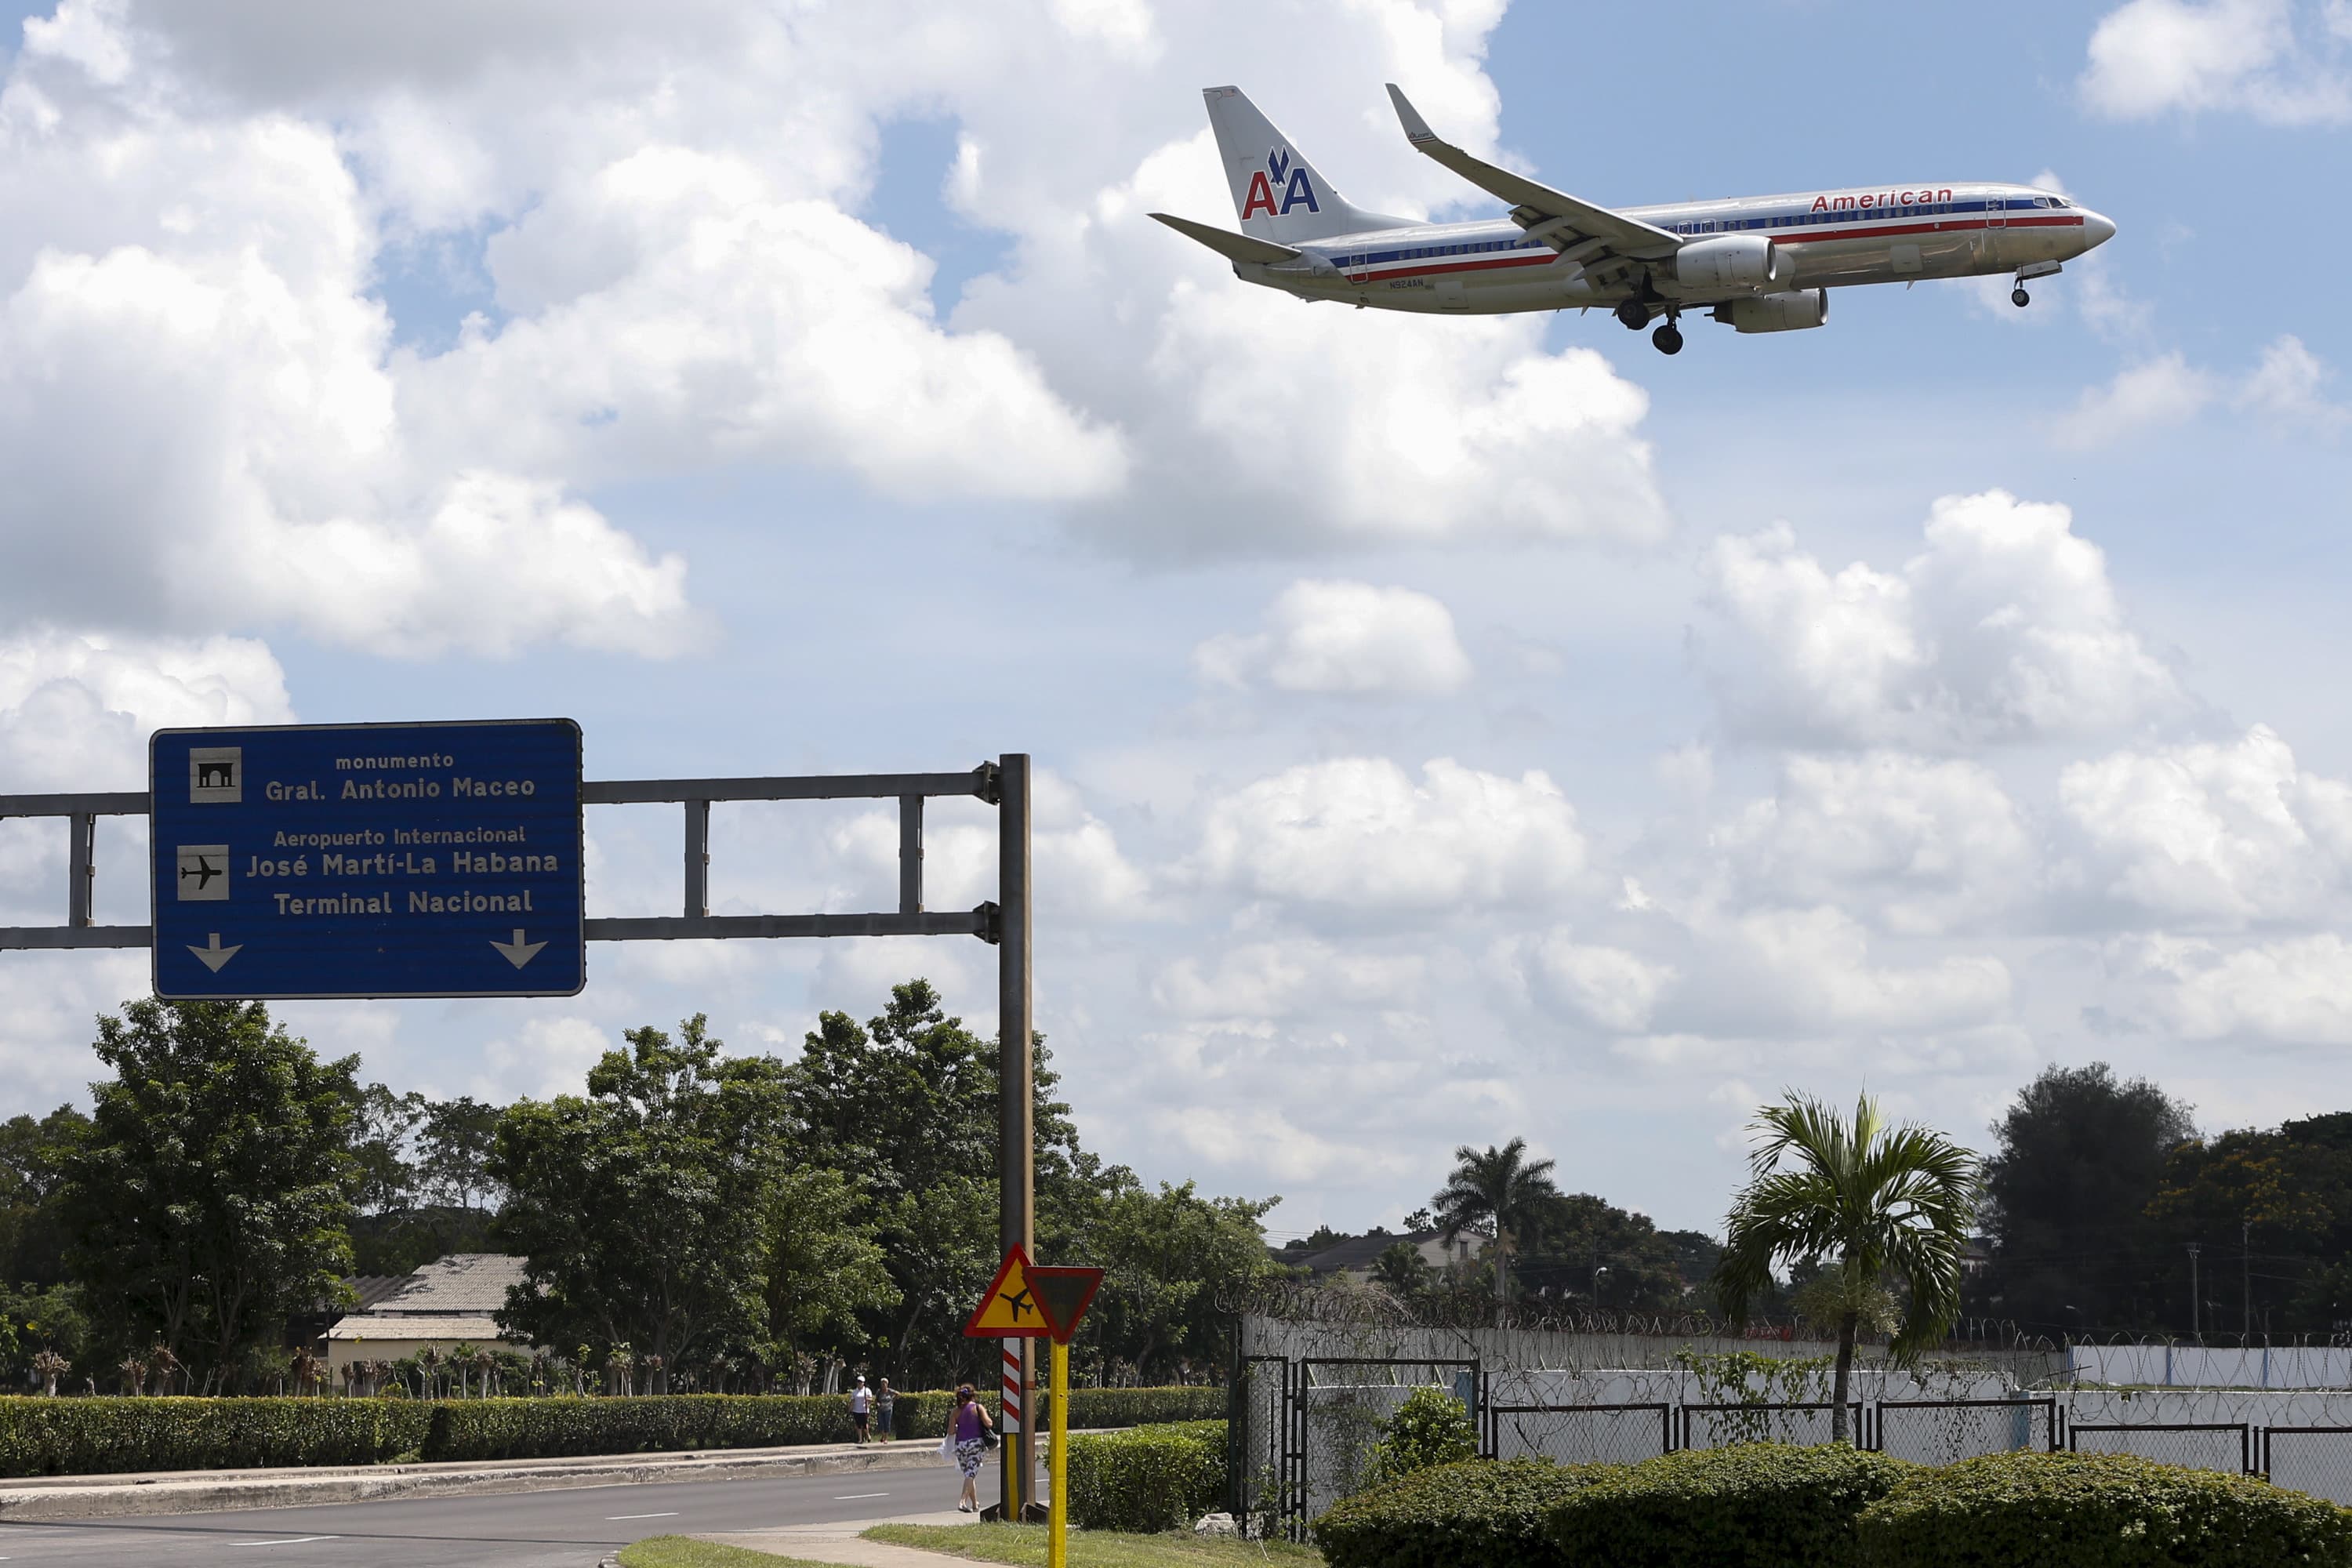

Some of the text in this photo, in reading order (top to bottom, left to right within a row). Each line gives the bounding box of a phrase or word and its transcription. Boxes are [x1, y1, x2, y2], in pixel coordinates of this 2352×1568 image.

[1241, 167, 1320, 221] AA
[1810, 188, 1953, 213] American
[1389, 278, 1424, 290] N924AN
[336, 753, 454, 770] monumento
[266, 777, 535, 800] Gral. Antonio Maceo
[274, 826, 526, 850] Aeropuerto Internacional
[246, 851, 557, 877] José Martí-La Habana
[274, 889, 532, 915] Terminal Nacional
